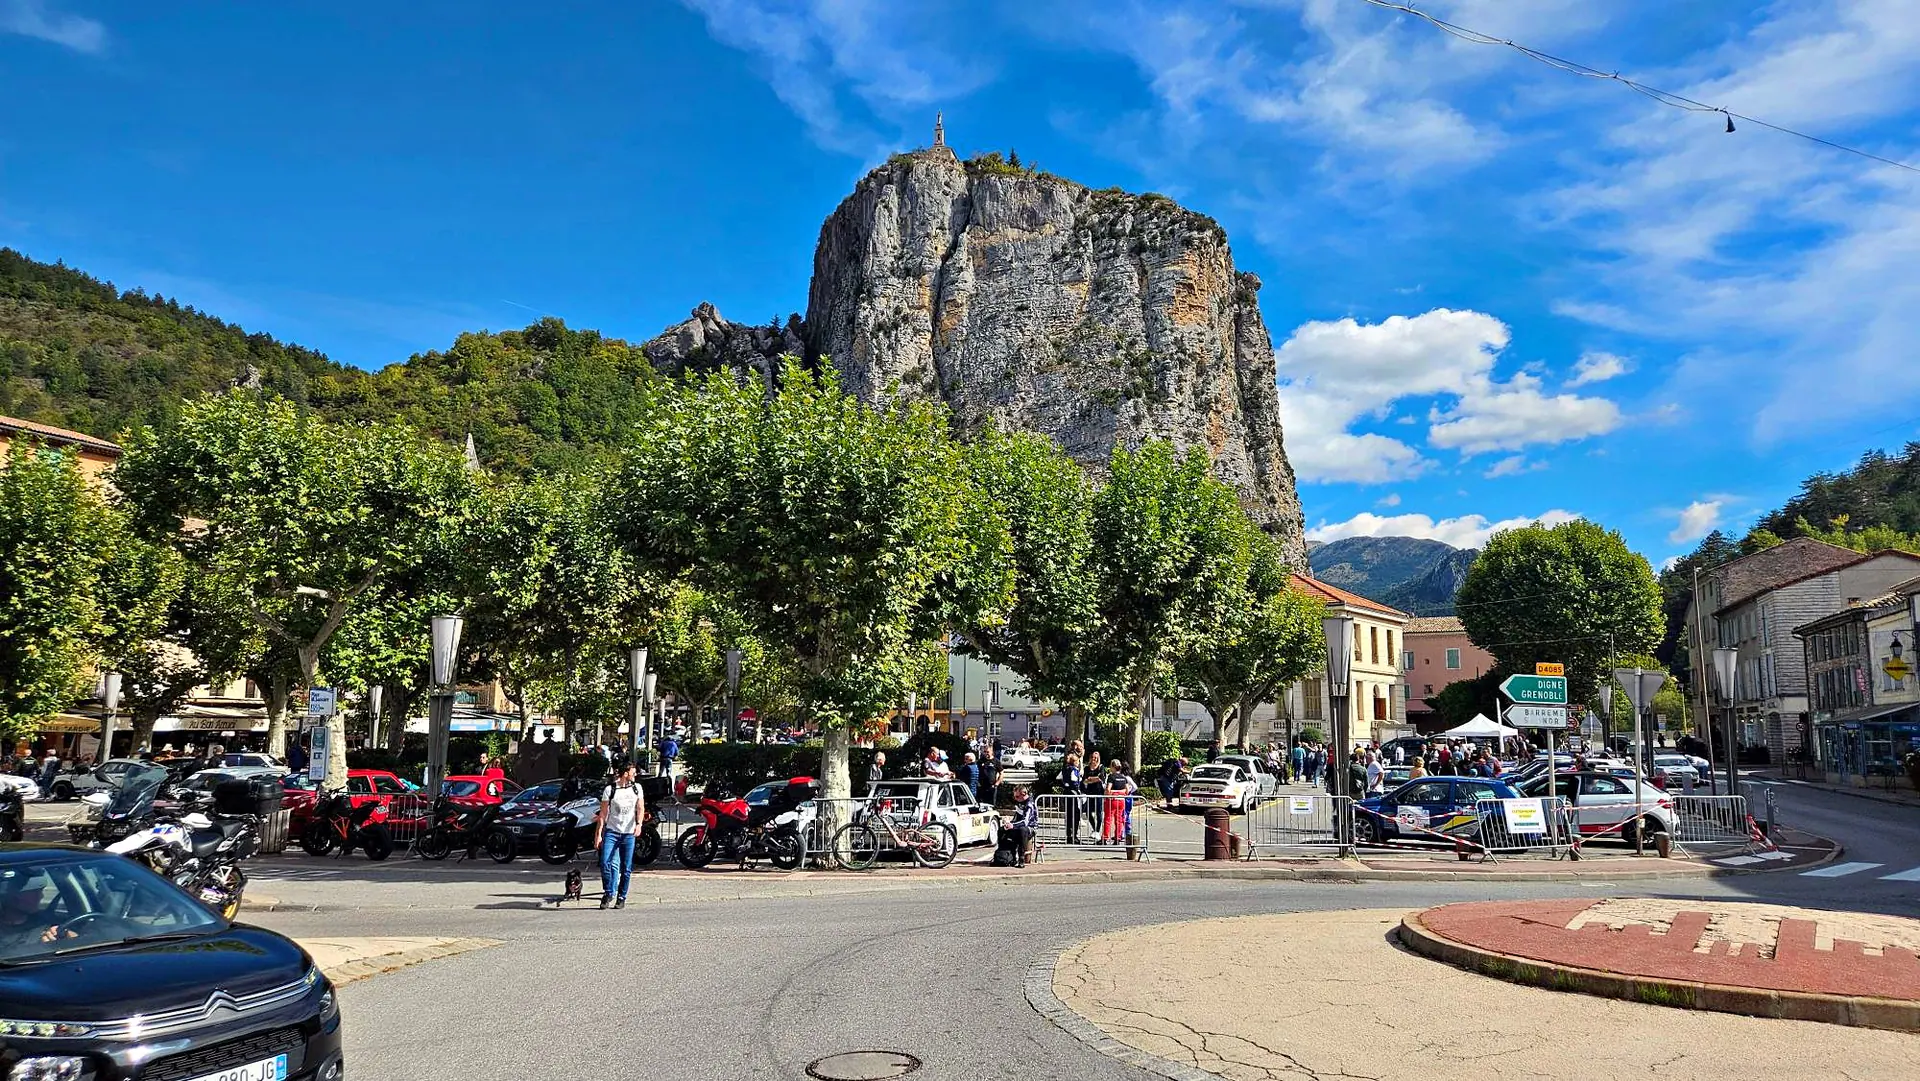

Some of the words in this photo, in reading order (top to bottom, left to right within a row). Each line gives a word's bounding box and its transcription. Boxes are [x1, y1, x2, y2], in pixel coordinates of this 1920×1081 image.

[1538, 665, 1562, 673] D4085
[1538, 680, 1562, 689] DIGNE
[1521, 690, 1562, 700] GRENOBLE
